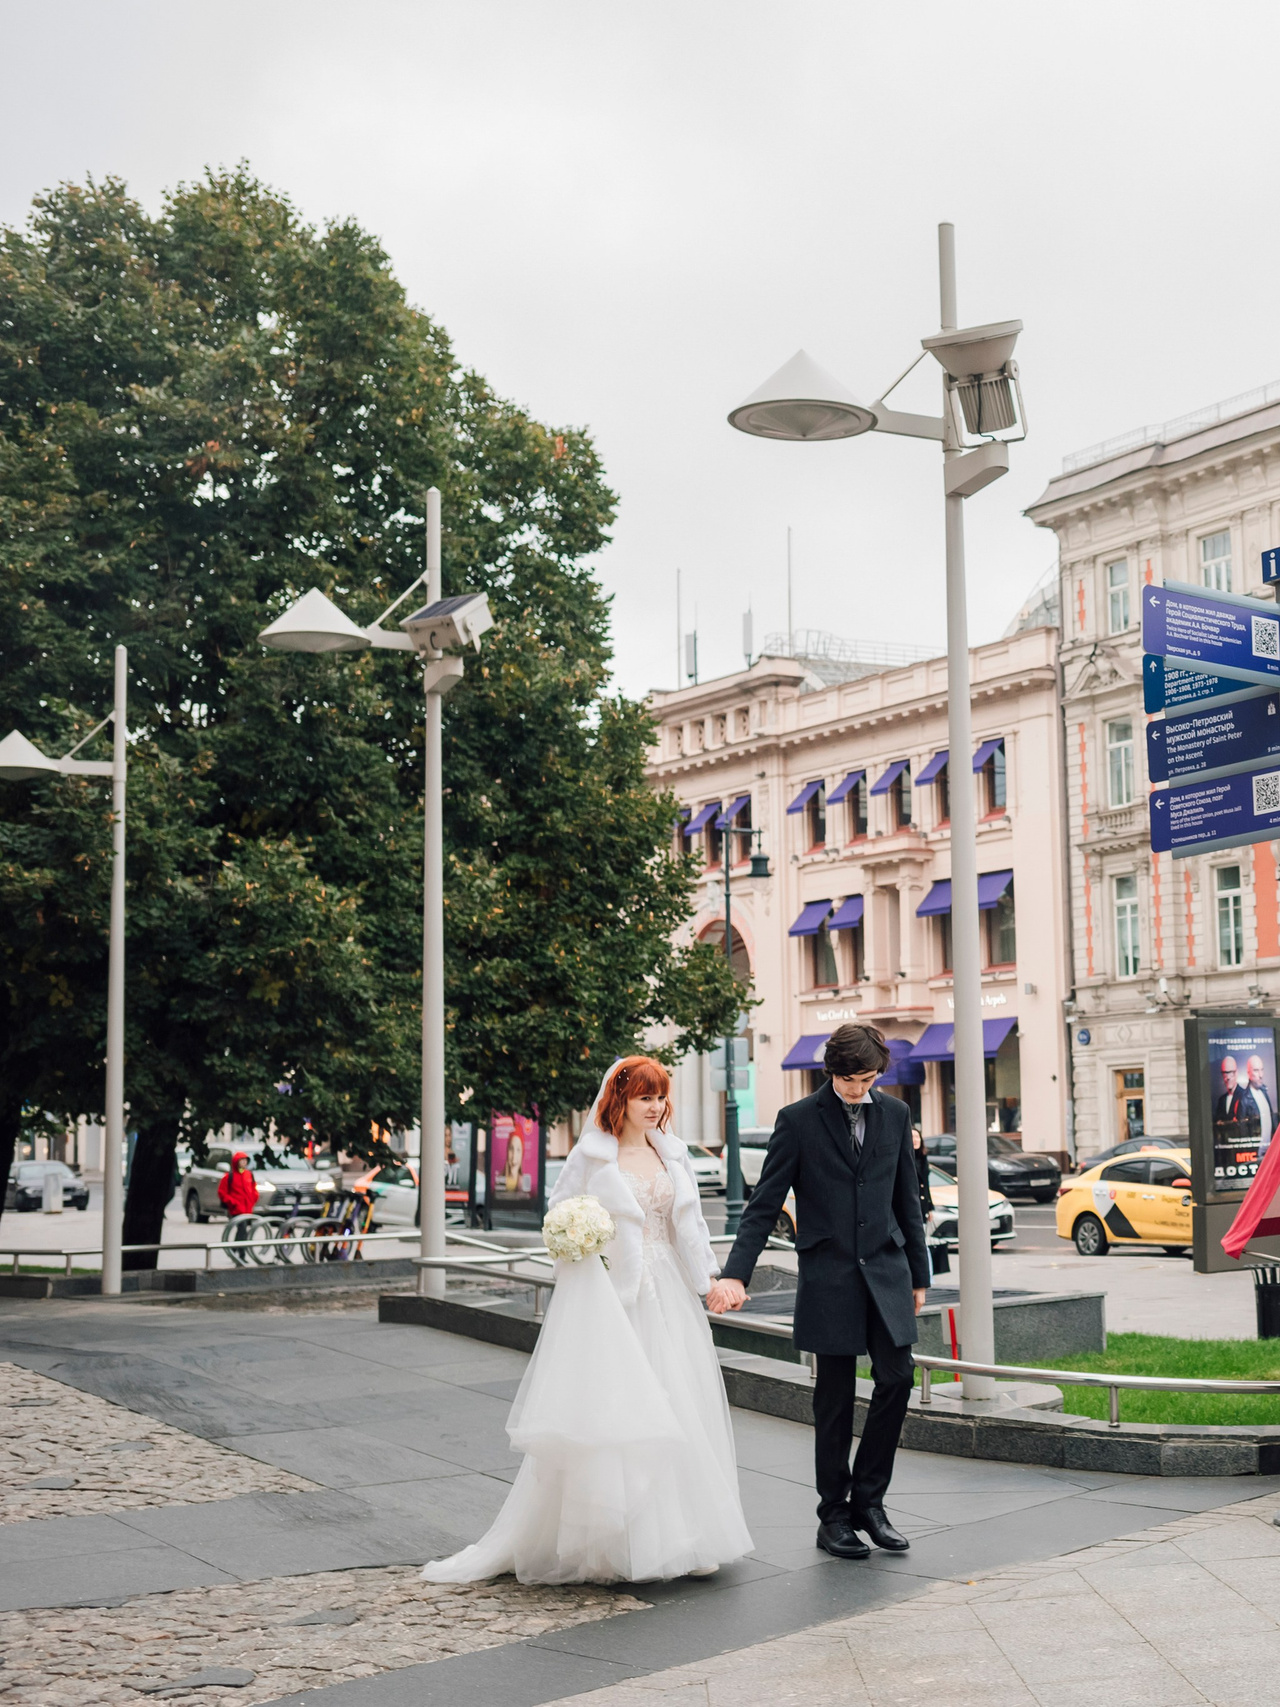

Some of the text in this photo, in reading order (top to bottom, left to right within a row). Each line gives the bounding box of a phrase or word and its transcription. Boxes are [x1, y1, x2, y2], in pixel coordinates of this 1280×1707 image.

[1166, 600, 1178, 609] Дом,
[1183, 605, 1204, 615] котором
[1216, 611, 1236, 621] дважды
[1166, 608, 1246, 631] Герой Социалистического Труда,
[1166, 617, 1191, 628] академик
[1201, 623, 1220, 634] Бочвар
[1165, 671, 1178, 681] 1908
[1165, 677, 1194, 689] Department
[1192, 677, 1218, 689] 1973-1978
[1166, 710, 1233, 734] Высоко-Петровский
[1166, 722, 1235, 745] мужской монастырь
[1177, 740, 1205, 751] Monastery
[1206, 736, 1212, 745] of
[1212, 735, 1227, 744] Saint
[1228, 732, 1242, 740] Peter
[1175, 754, 1184, 762] the
[1185, 750, 1203, 760] Ascent
[1185, 791, 1205, 800] котором
[1216, 784, 1231, 793] Герой
[1170, 801, 1195, 810] Советского
[1183, 807, 1204, 816] Джалиль
